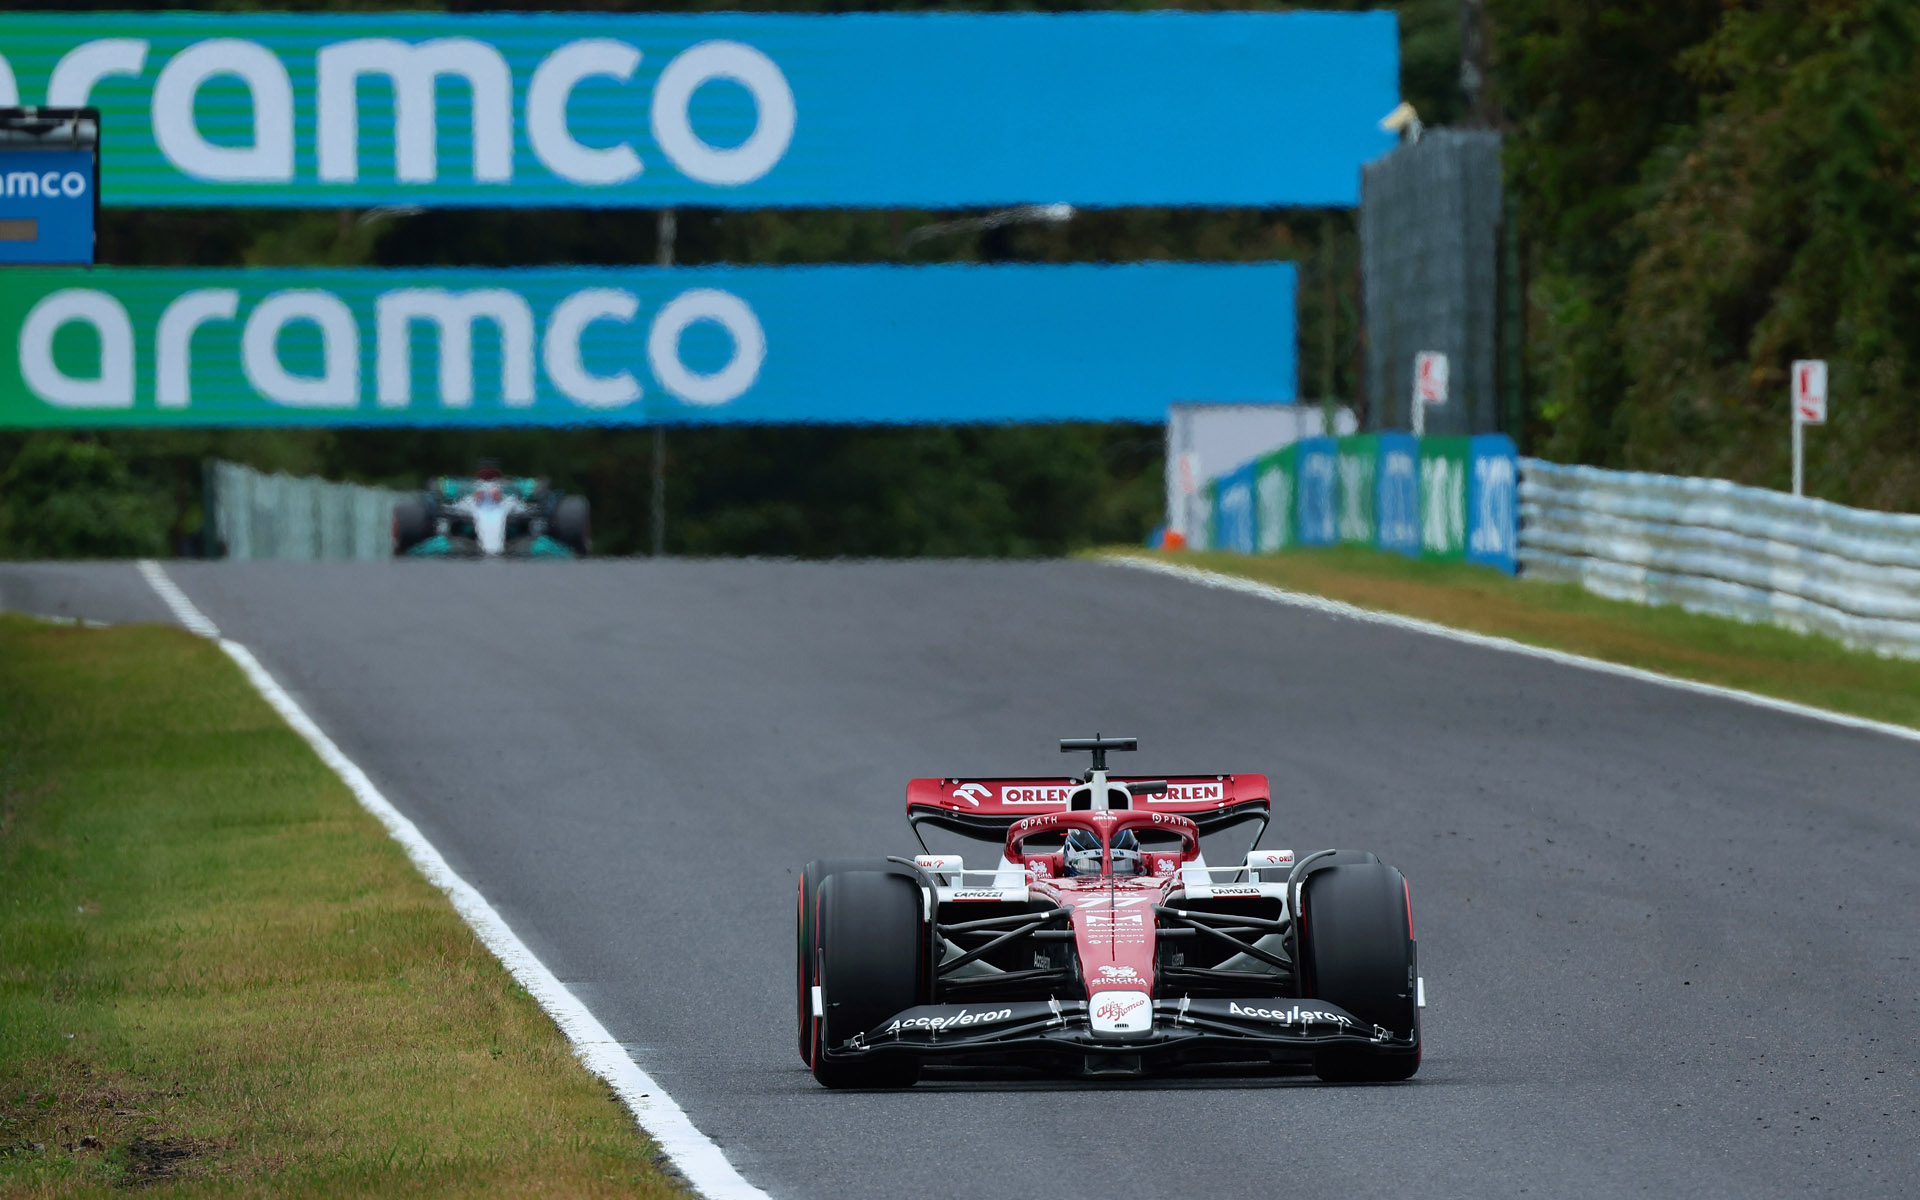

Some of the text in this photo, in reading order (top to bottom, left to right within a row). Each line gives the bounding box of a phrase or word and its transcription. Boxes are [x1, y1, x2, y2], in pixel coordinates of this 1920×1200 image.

[0, 37, 796, 186] ramco
[0, 171, 85, 197] mco
[18, 288, 767, 409] aramco
[1030, 816, 1058, 827] PATH
[1163, 815, 1188, 827] PATH
[1076, 896, 1148, 908] 77
[1091, 977, 1148, 987] SINGHA
[885, 1008, 1012, 1032] Accelleron
[1096, 999, 1145, 1021] Alfa Romeo
[1230, 1002, 1353, 1025] Accelleron
